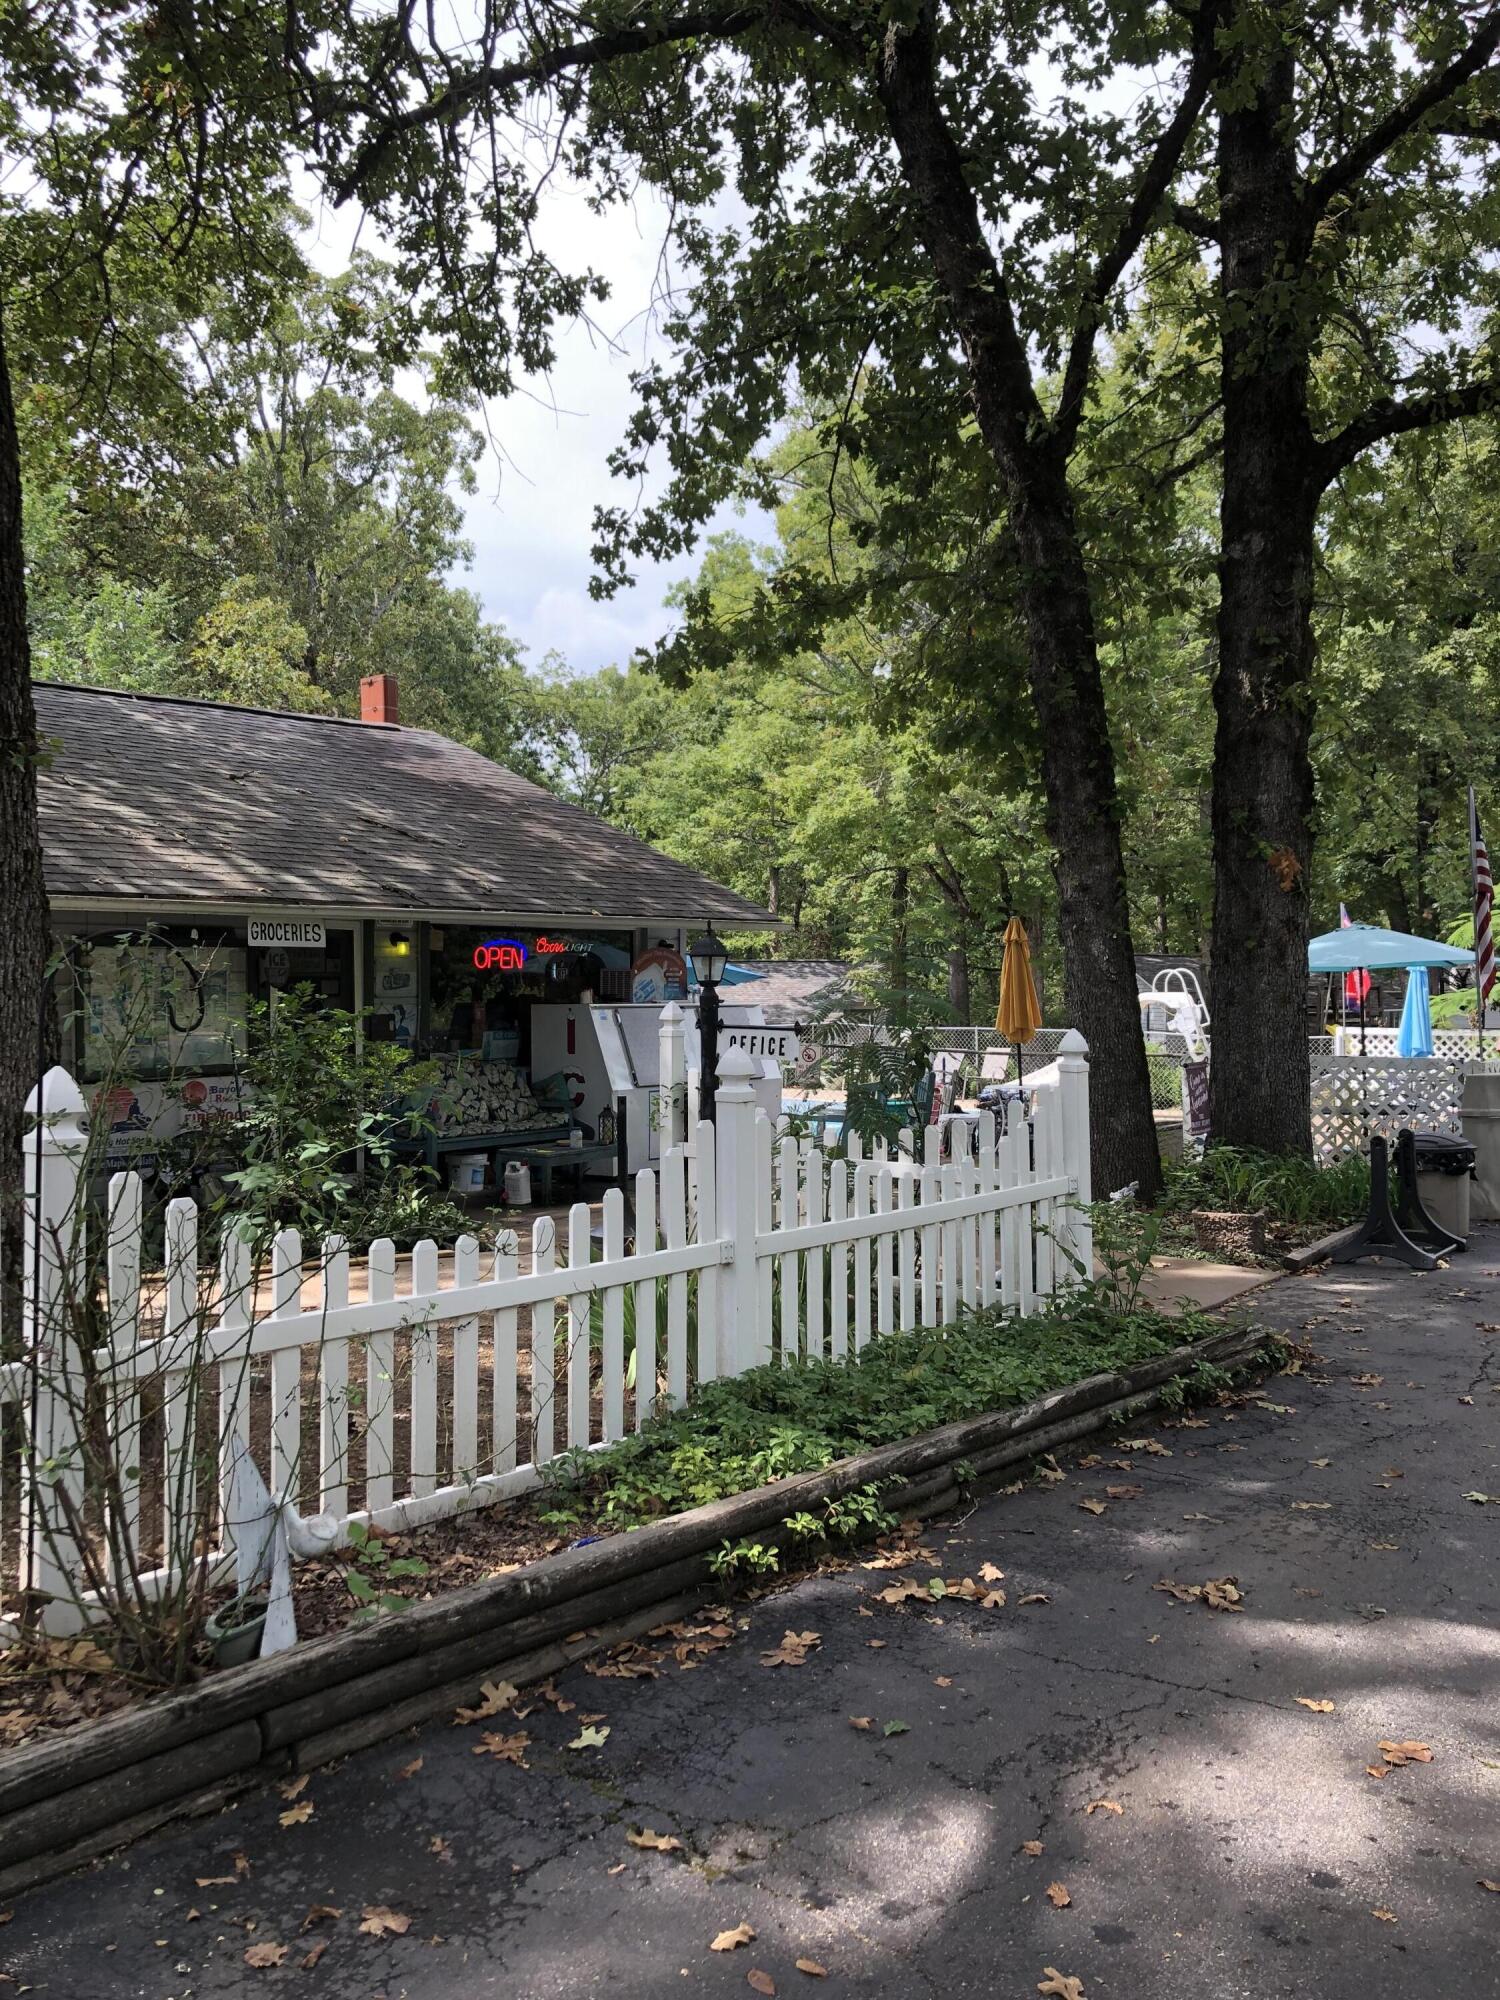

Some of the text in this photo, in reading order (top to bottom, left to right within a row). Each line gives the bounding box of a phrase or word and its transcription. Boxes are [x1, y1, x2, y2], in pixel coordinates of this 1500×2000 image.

[250, 921, 322, 943] GROCERIES
[536, 937, 594, 953] Coors LIGHT
[268, 952, 287, 967] ICE
[473, 946, 524, 969] OPEN
[729, 1035, 787, 1056] OFFICE
